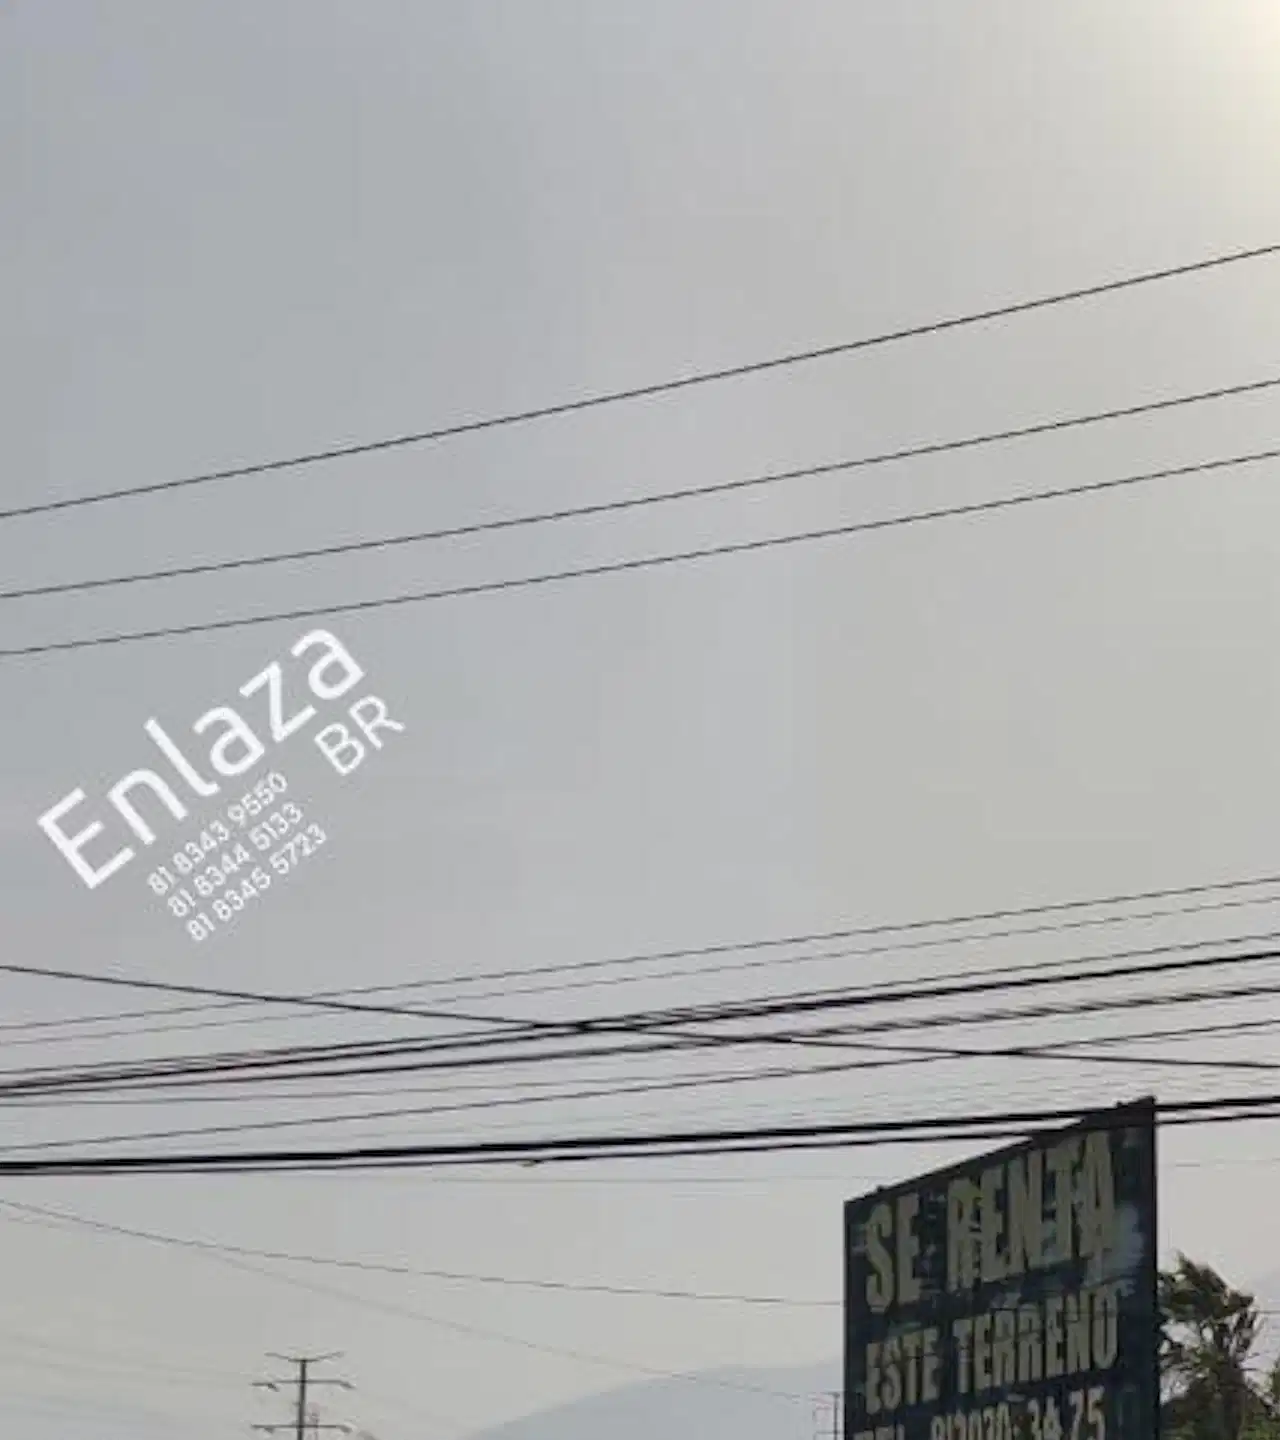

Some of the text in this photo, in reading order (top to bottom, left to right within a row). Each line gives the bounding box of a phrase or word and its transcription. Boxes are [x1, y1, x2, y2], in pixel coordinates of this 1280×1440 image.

[865, 1129, 1115, 1315] SE RENTA
[866, 1285, 1120, 1415] ESTE TERRENO
